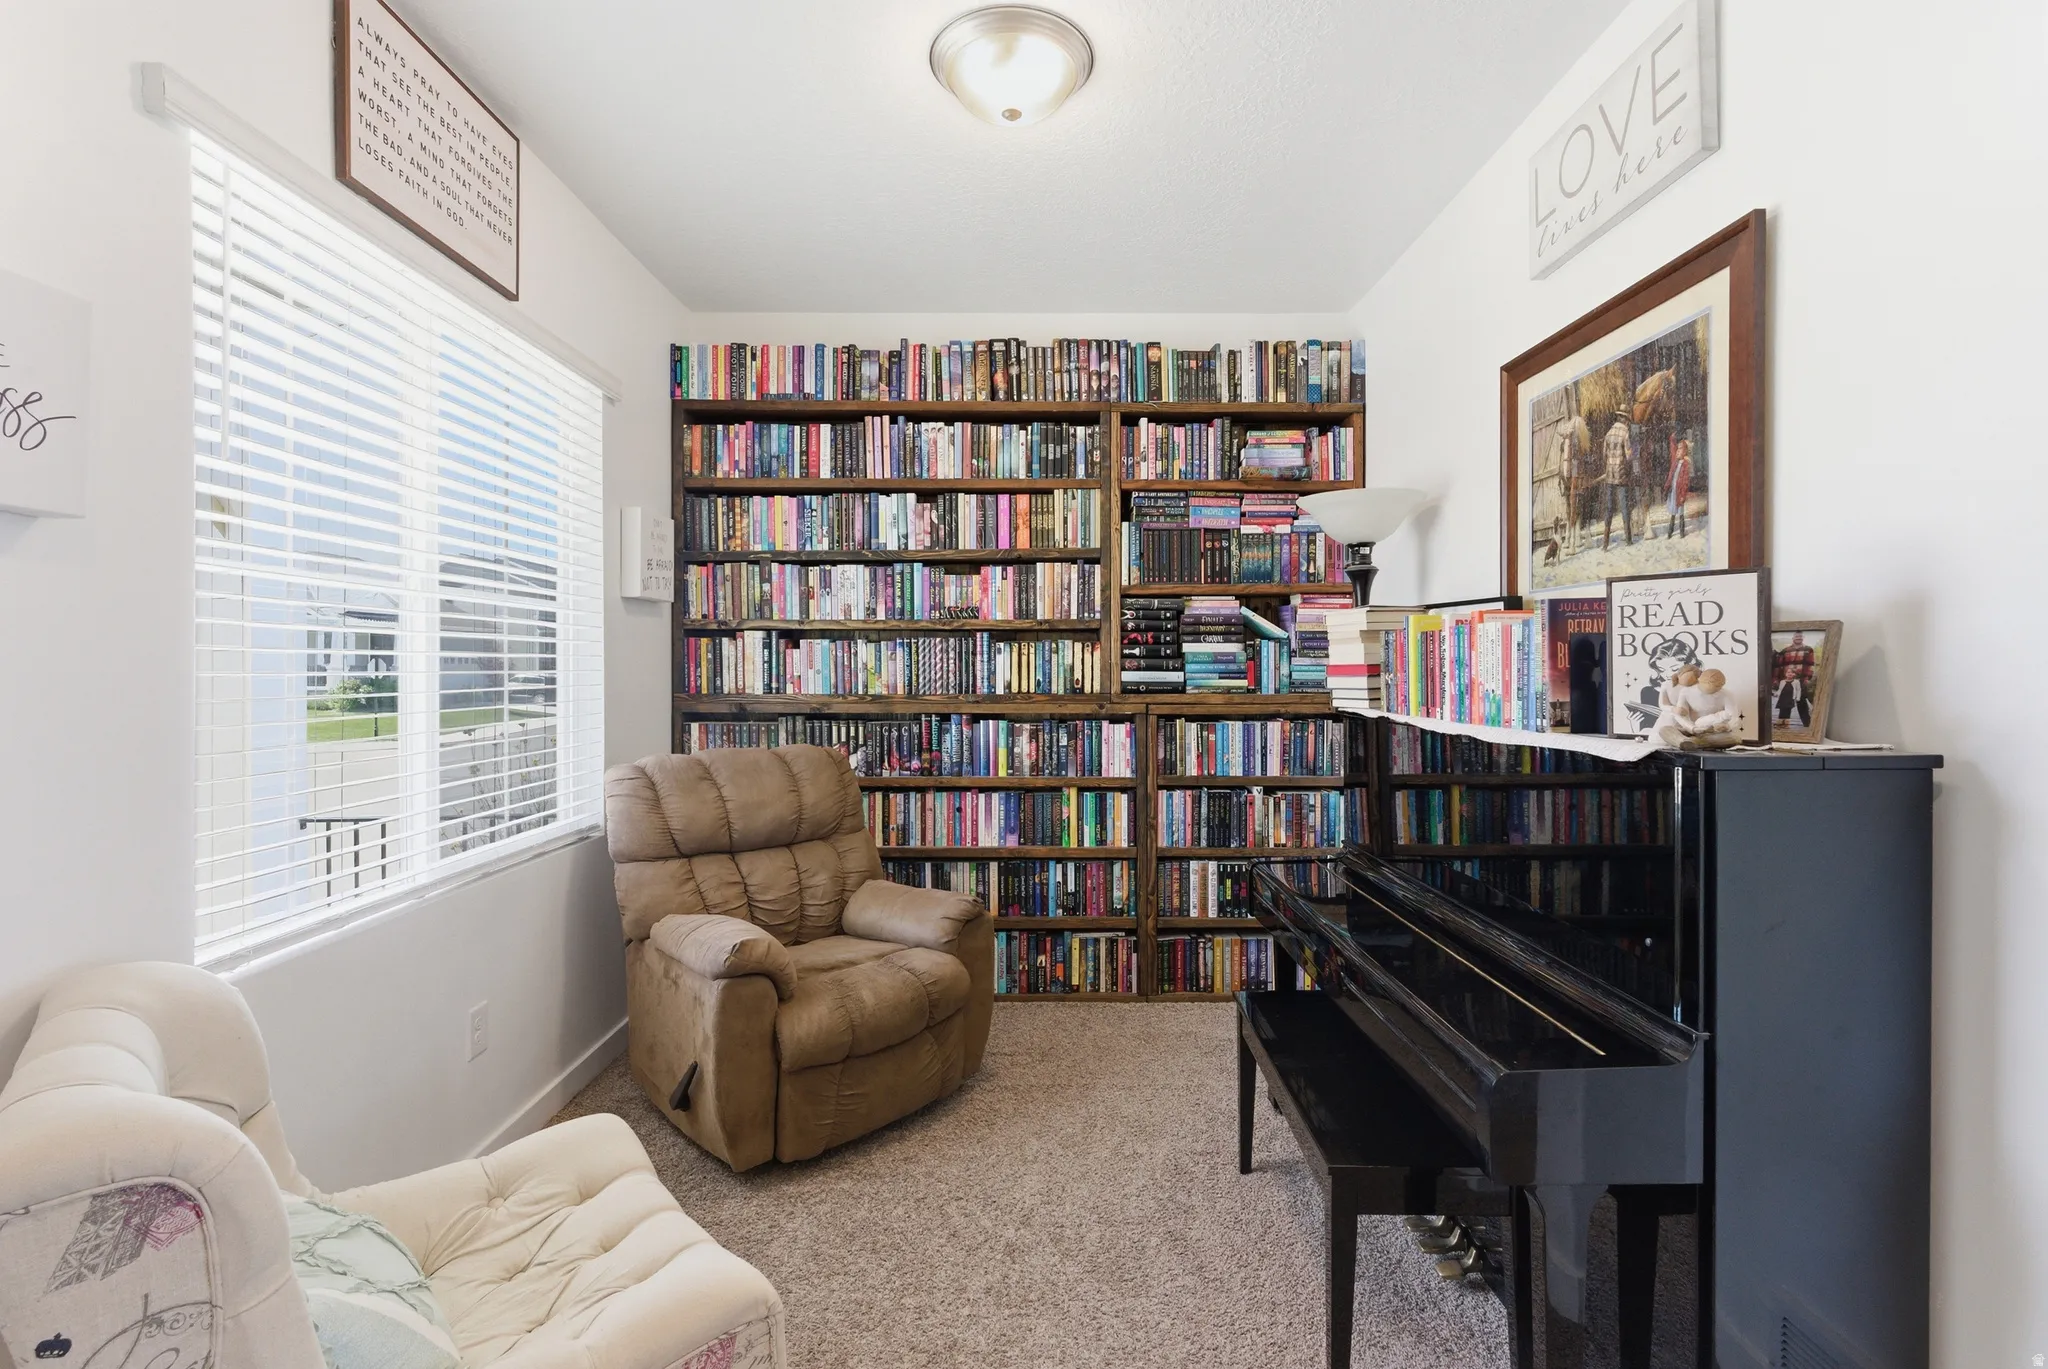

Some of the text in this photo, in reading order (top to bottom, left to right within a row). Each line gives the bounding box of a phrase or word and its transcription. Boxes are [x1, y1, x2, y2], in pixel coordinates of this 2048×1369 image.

[357, 17, 514, 171] ALWAYS PRAY TO HAVE EYES
[357, 40, 386, 73] THAT
[392, 72, 412, 96] SEE
[417, 94, 435, 119] THE
[440, 117, 462, 144] BEST
[466, 141, 476, 156] IN
[358, 65, 513, 208] A HEART THAT FORGIVES THE
[1534, 22, 1687, 228] LOVE
[358, 112, 379, 137] THE
[409, 156, 429, 178] AND
[431, 174, 438, 185] A
[440, 181, 462, 206] SOUL
[464, 201, 485, 224] THAT
[487, 219, 513, 246] NEVER
[358, 137, 468, 230] LOSES FAITH IN GOD.
[407, 132, 414, 144] A
[420, 142, 445, 170] MIND
[450, 168, 472, 193] THAT
[476, 190, 513, 227] FORGETS
[1537, 125, 1688, 258] lives here
[1558, 601, 1607, 612] JULIA KE
[1617, 600, 1724, 629] READ
[1617, 629, 1749, 657] BOOKS
[1668, 583, 1713, 600] girls
